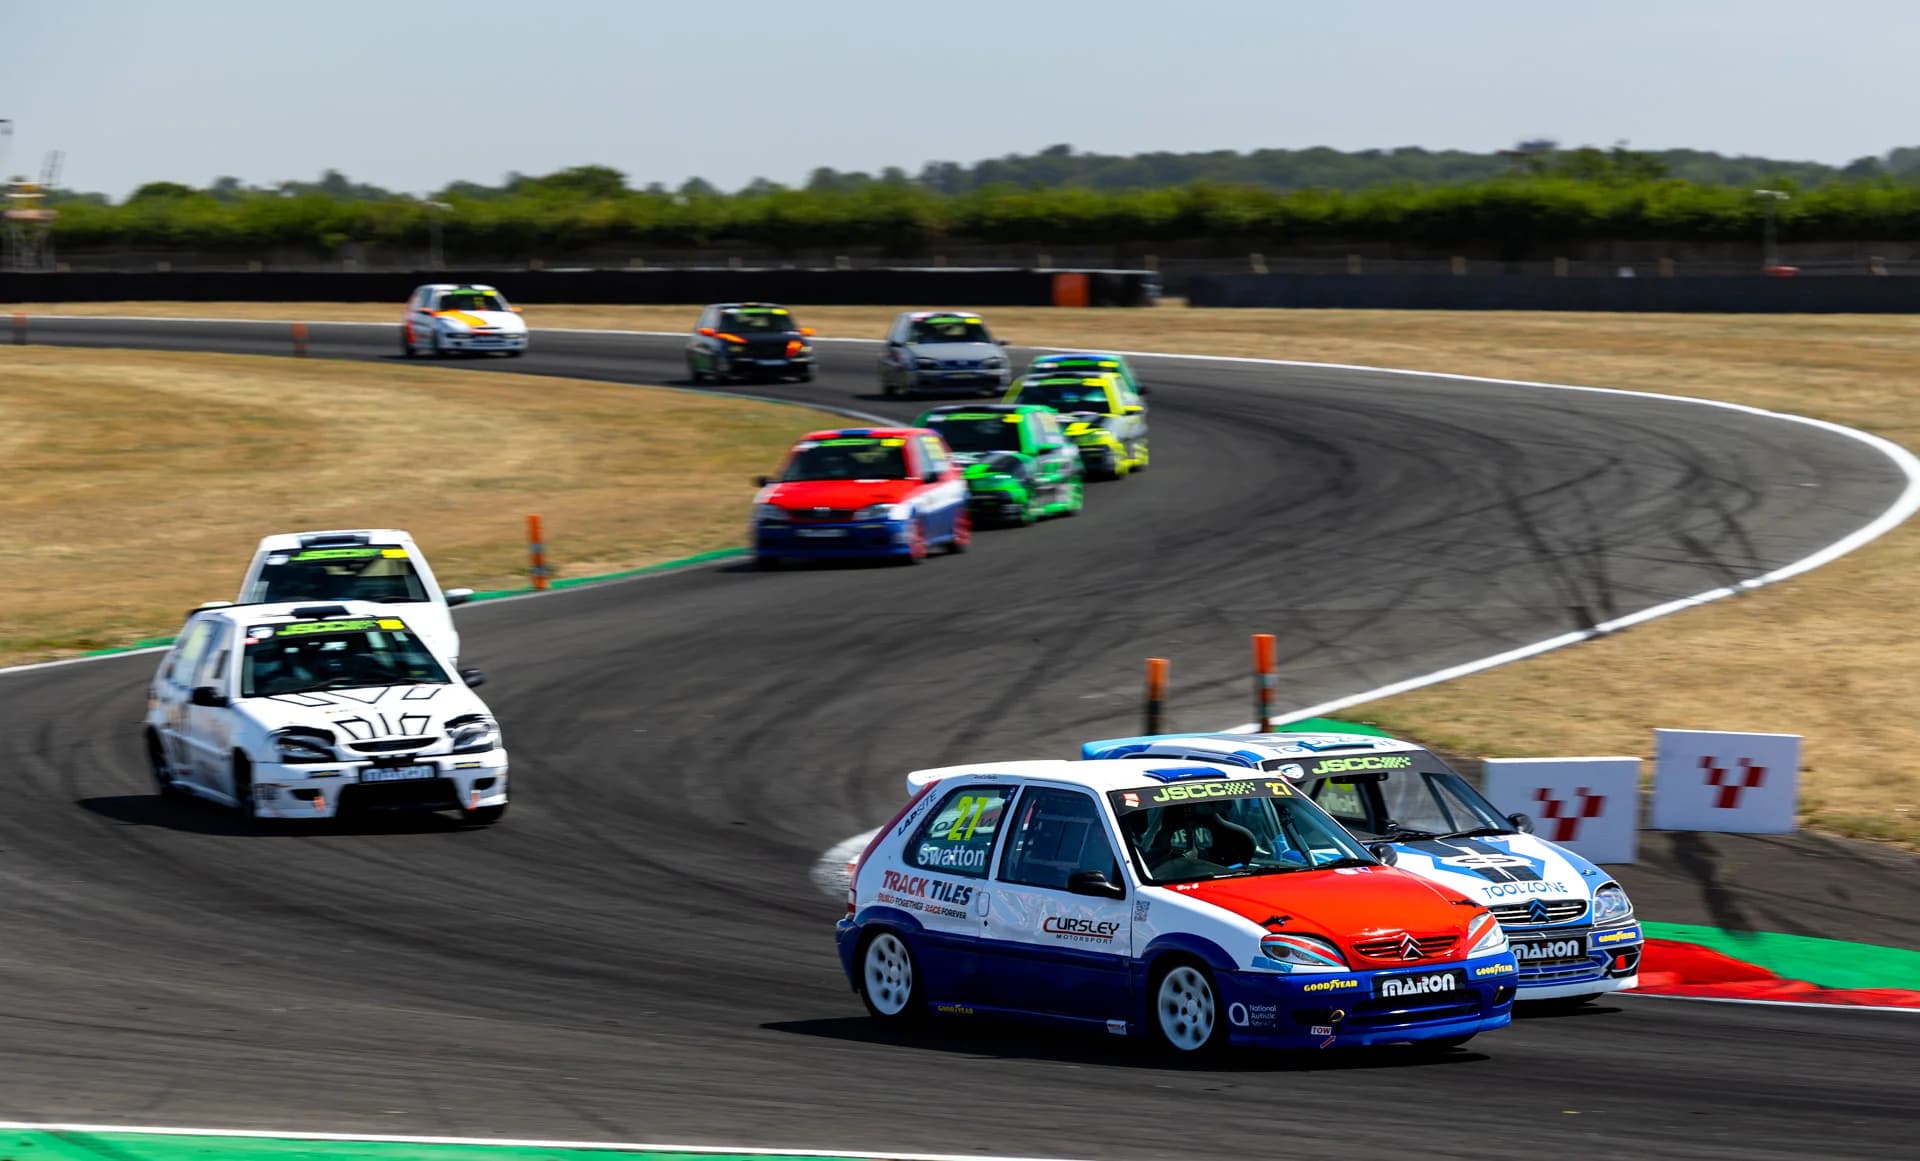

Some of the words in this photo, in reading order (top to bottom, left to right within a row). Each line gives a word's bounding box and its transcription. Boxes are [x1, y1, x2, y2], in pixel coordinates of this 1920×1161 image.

[1312, 757, 1382, 775] JSCC
[1153, 782, 1226, 802] JSCC
[1264, 782, 1293, 797] 27
[947, 795, 989, 841] 27
[917, 843, 985, 867] Swatton
[882, 869, 929, 898] TRACK
[931, 880, 973, 906] TILES
[1482, 881, 1568, 899] TOOLZONE
[895, 897, 923, 911] TOGETHER
[941, 907, 967, 920] FOREVER
[1043, 916, 1120, 939] CURSLEY
[1056, 934, 1113, 945] MOTORSPORT
[1304, 979, 1358, 992] GOODYEAR
[1249, 1004, 1277, 1012] National
[1312, 1026, 1331, 1035] TOW
